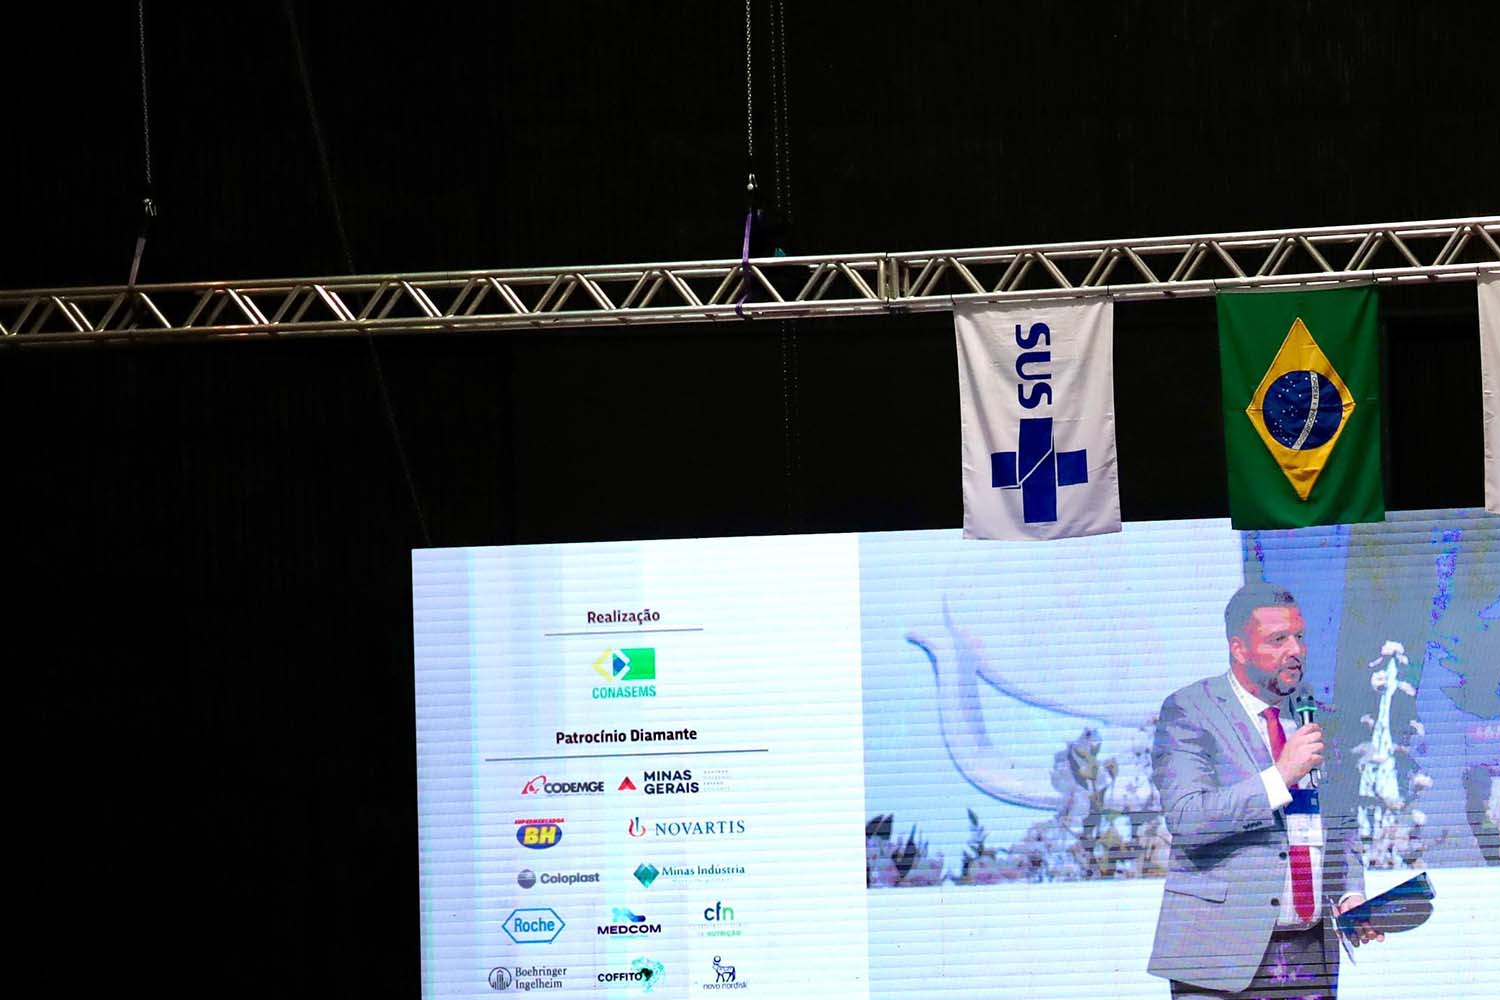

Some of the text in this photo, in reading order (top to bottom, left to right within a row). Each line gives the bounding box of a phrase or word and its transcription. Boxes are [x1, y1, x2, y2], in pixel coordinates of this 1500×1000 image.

[1015, 322, 1053, 410] SUS
[587, 609, 660, 625] Realização
[592, 685, 656, 699] CONASEMS
[556, 728, 697, 744] Patrocínio Diamante
[644, 769, 692, 782] MINAS
[544, 780, 605, 794] CODEMGE
[645, 782, 699, 795] GERAIS
[655, 819, 745, 836] NOVARTIS
[524, 826, 556, 845] BH
[662, 864, 745, 876] Minas Indústria
[540, 872, 600, 885] Coloplast
[704, 901, 734, 921] cfn
[514, 918, 555, 933] Roche
[597, 924, 661, 935] MEDCOM
[515, 966, 567, 979] Boehringer
[598, 972, 642, 983] COFFITO
[515, 978, 563, 990] Ingelheim
[722, 980, 747, 989] nordisk
